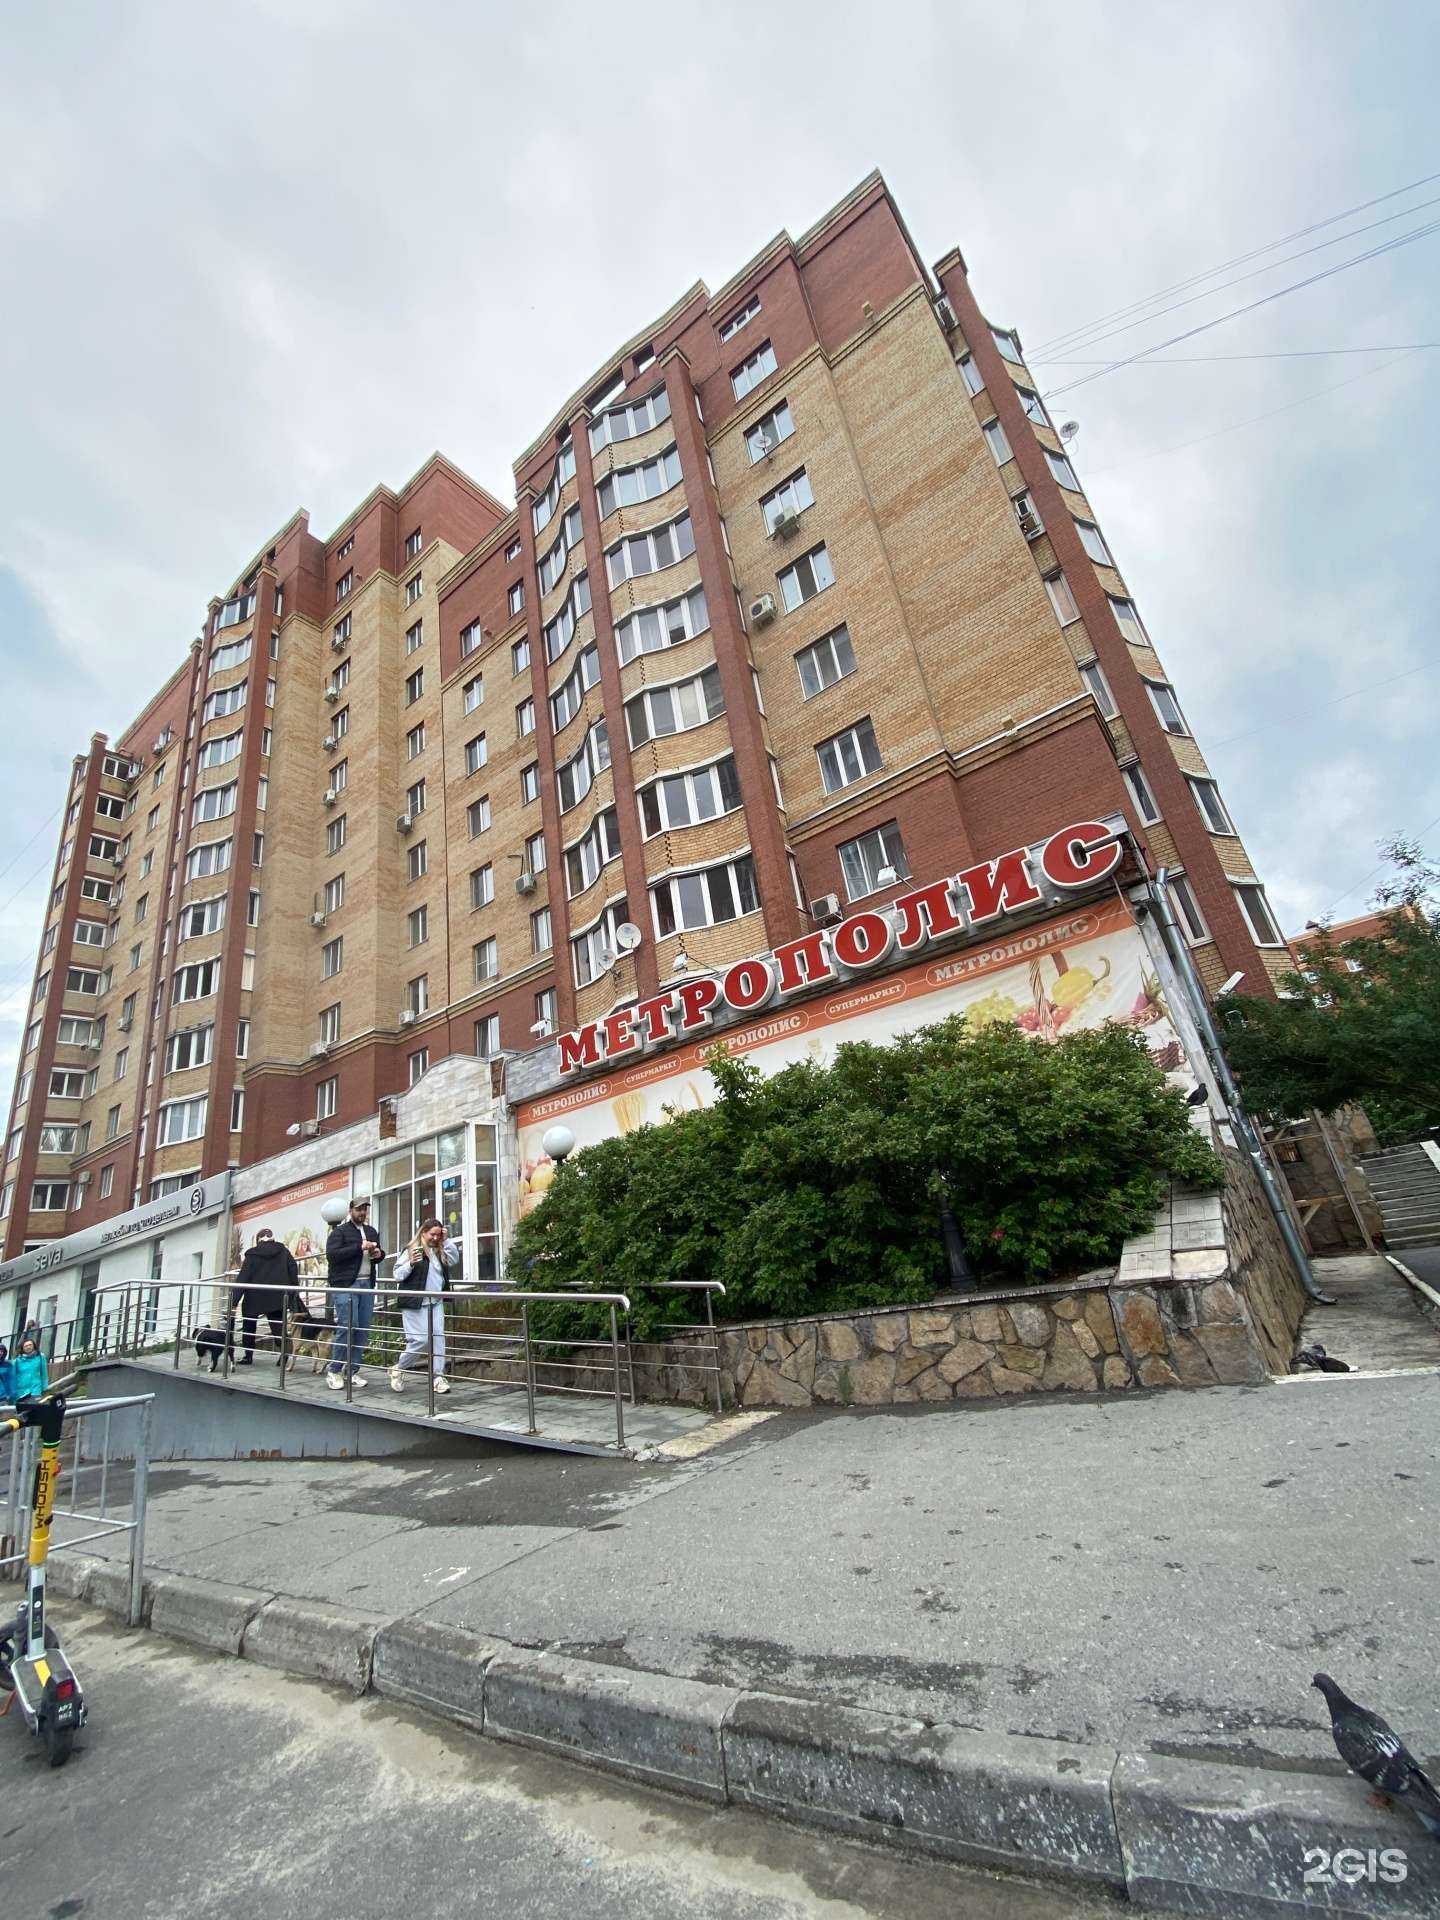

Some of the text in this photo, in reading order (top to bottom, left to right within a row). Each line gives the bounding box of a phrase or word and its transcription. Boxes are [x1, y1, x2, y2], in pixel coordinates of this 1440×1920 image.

[531, 1083, 608, 1117] МЕТРОПОЛИС
[626, 1061, 678, 1084] СУПЕРМАРКЕТ
[829, 984, 901, 1014] СУПЕРМАРКЕТ
[933, 918, 1089, 982] МЕТРОПОЛИС
[558, 821, 1122, 1075] МЕТРОПОЛИС
[32, 1247, 64, 1272] seva
